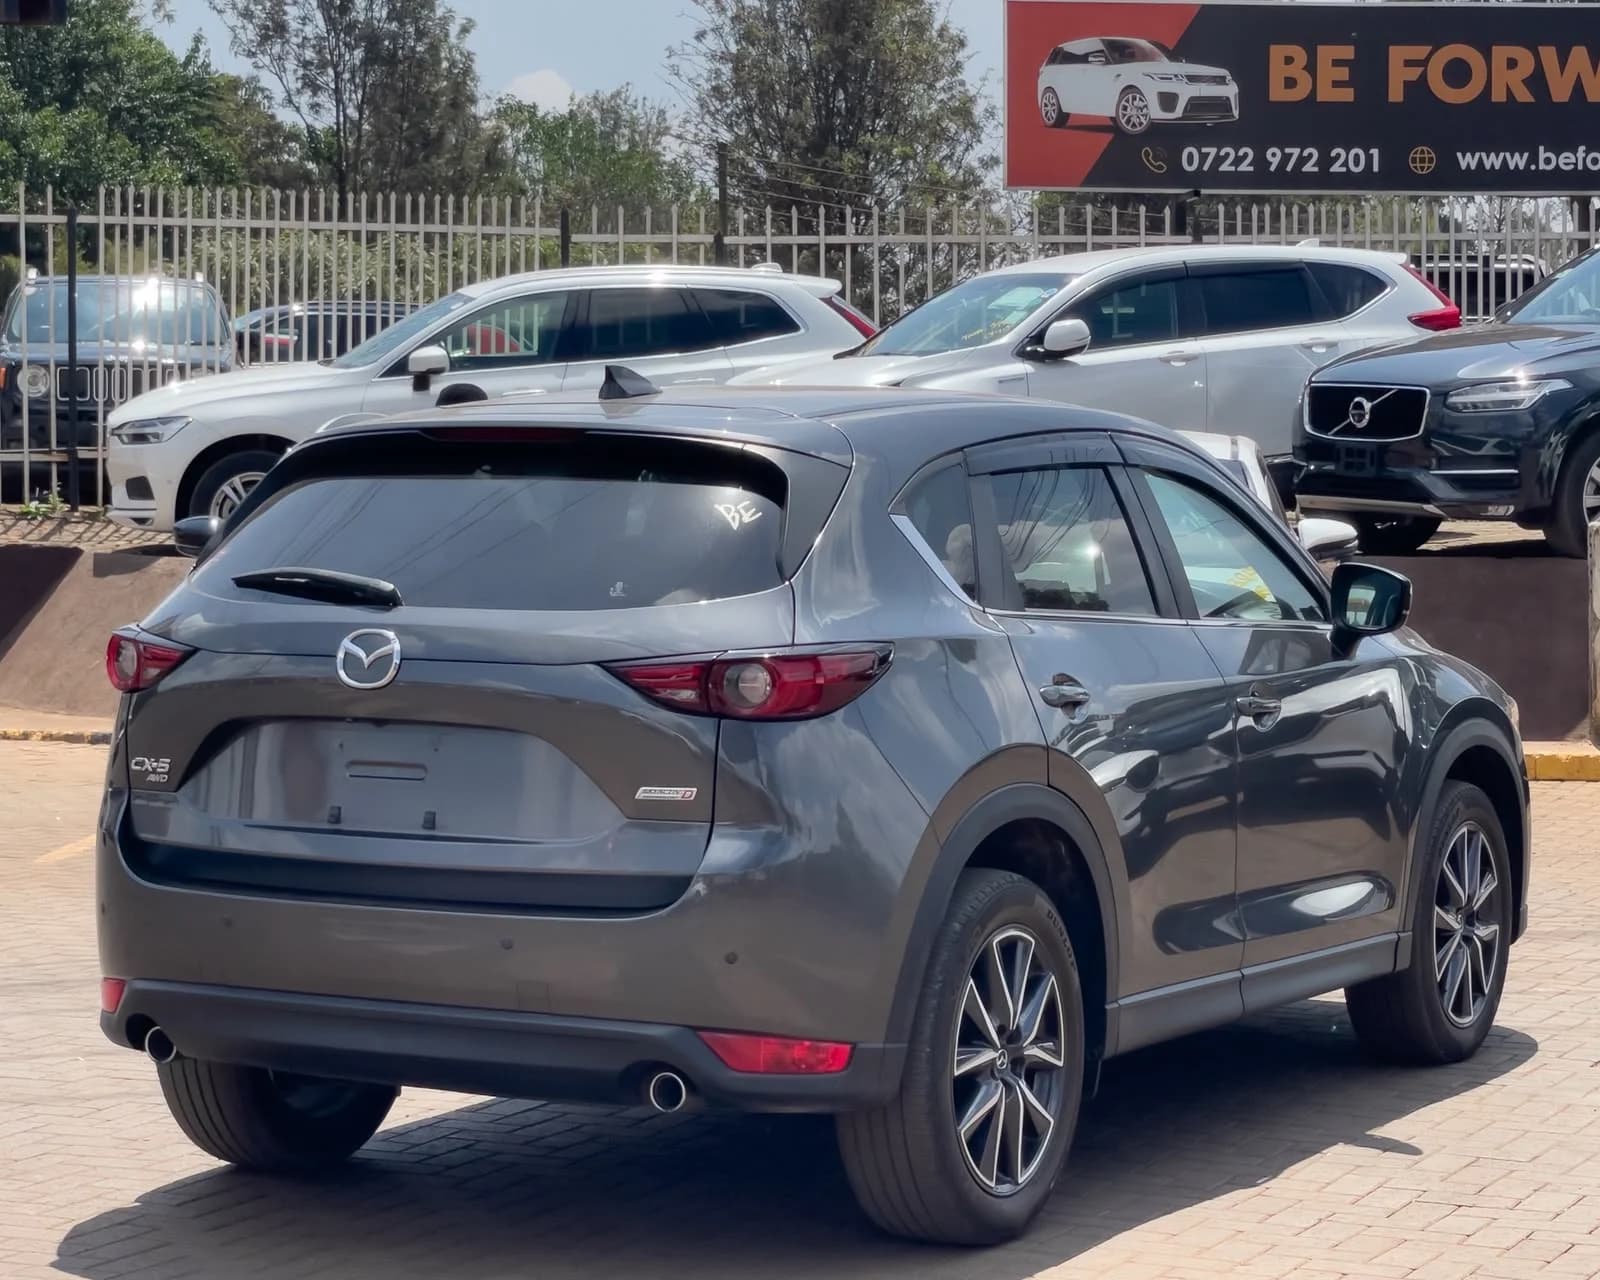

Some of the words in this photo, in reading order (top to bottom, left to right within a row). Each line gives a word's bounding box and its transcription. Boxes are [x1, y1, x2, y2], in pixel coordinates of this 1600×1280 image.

[1269, 44, 1355, 102] BE
[1388, 43, 1600, 104] FORW
[1181, 147, 1254, 171] 0722
[1265, 147, 1319, 172] 972
[1329, 147, 1379, 173] 201
[1456, 145, 1600, 171] www.befo
[713, 500, 763, 531] BE
[131, 757, 171, 772] CX-5
[146, 774, 169, 783] AWD
